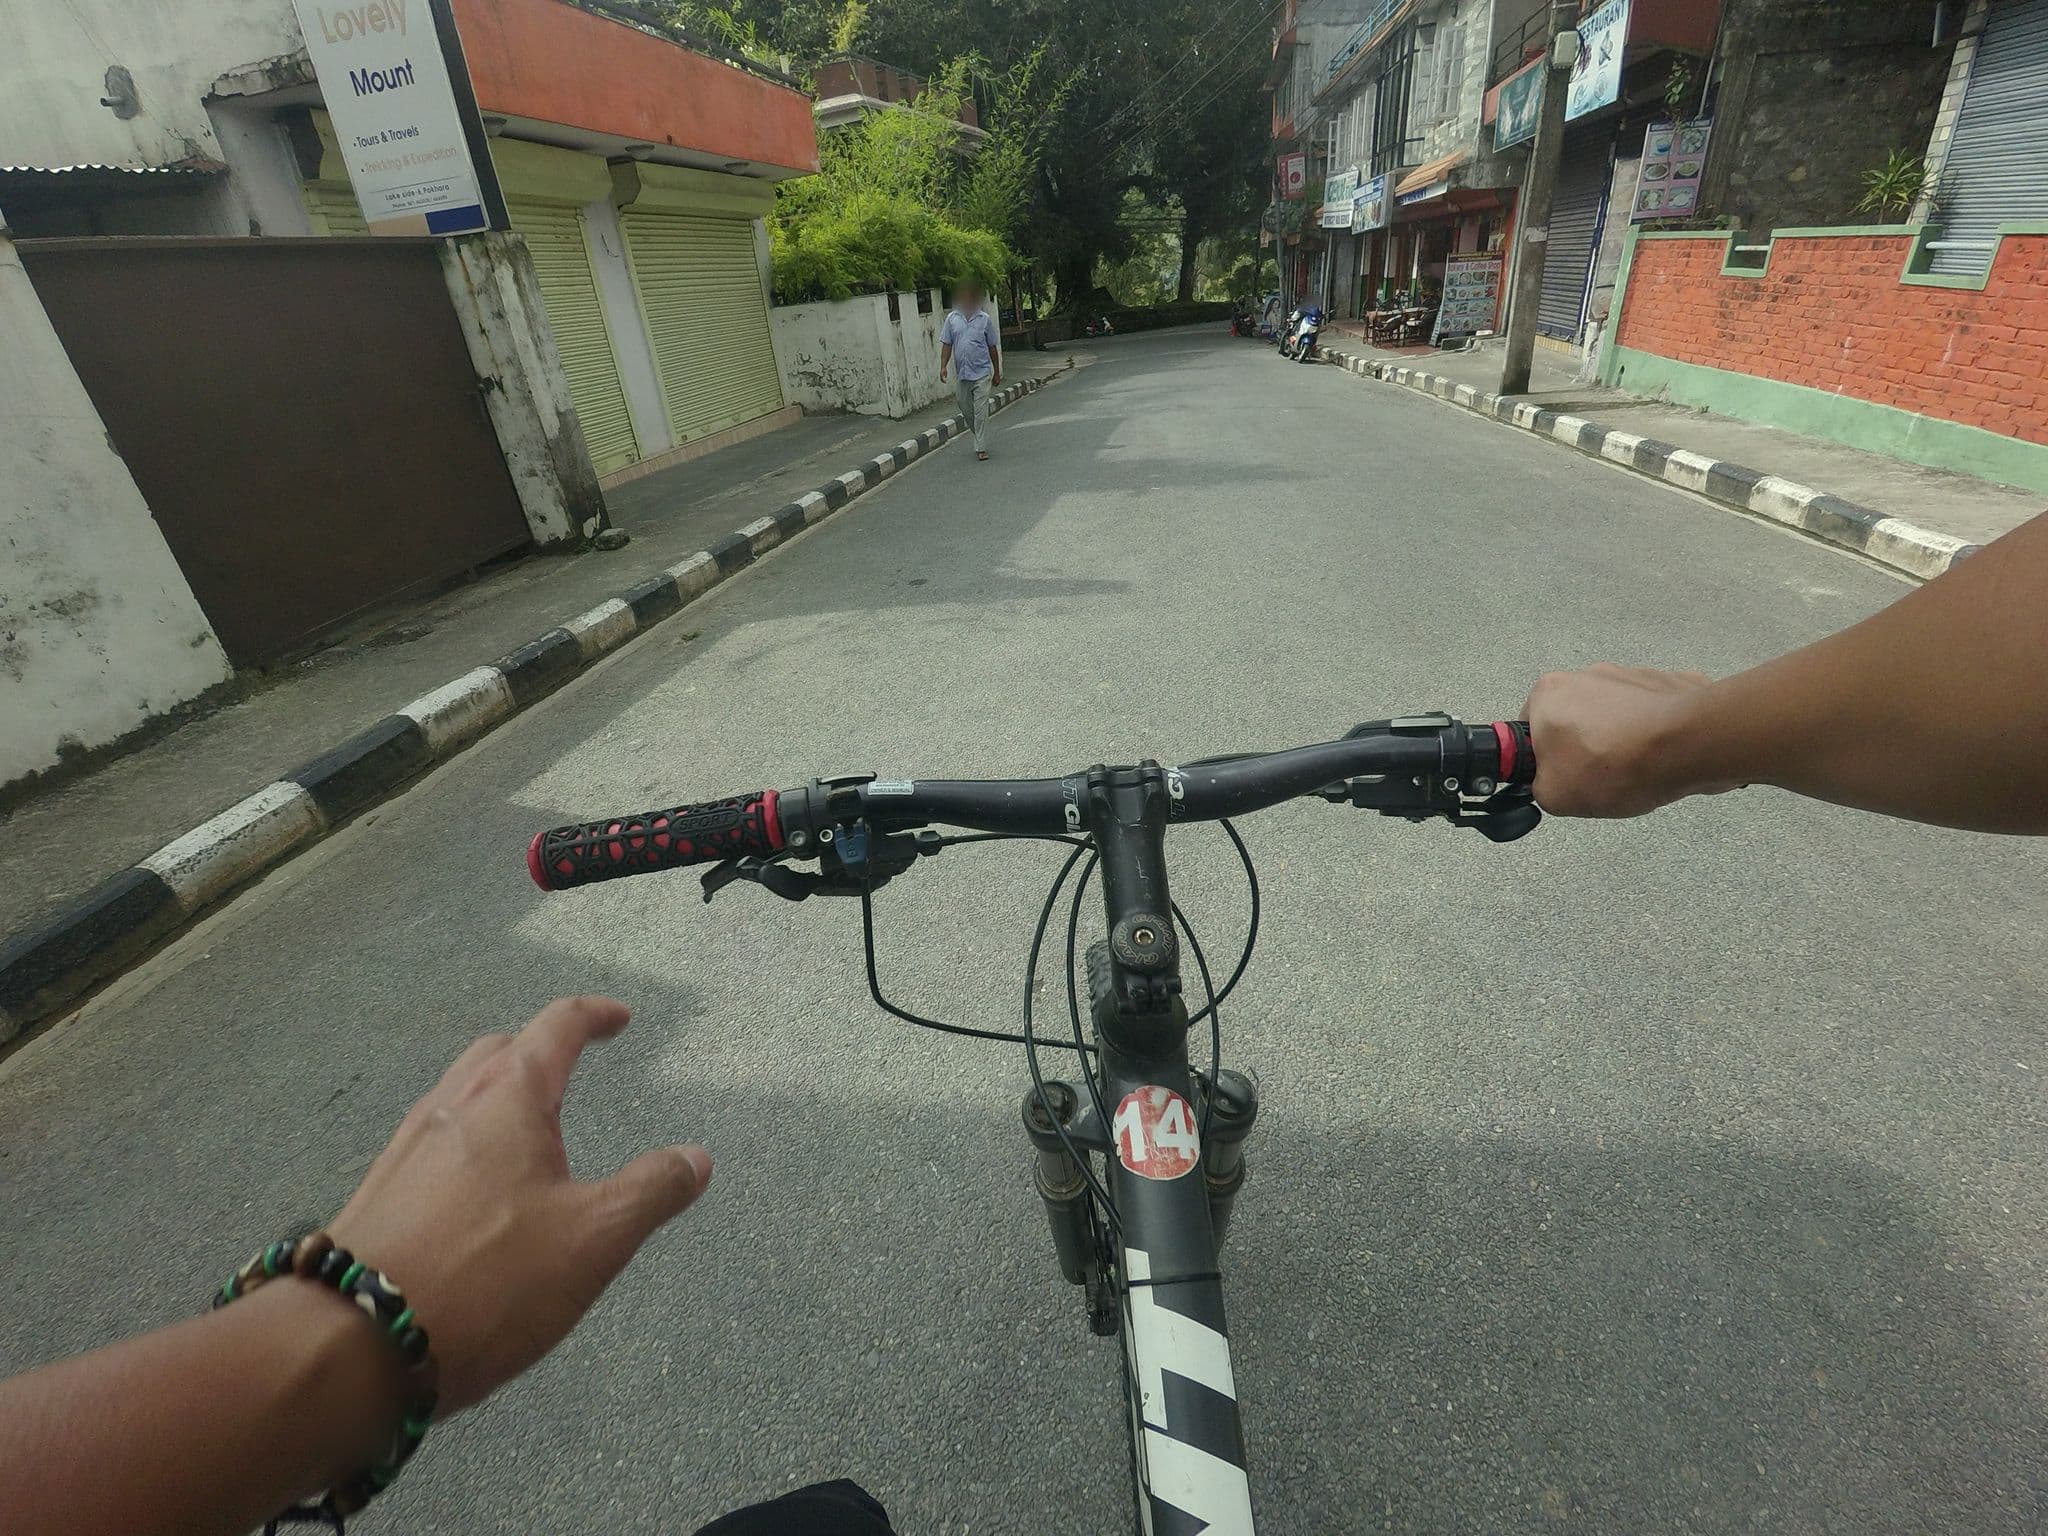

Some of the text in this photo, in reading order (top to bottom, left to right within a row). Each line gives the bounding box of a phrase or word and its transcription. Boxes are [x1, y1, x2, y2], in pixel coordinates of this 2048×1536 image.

[317, 0, 407, 44] Lovely
[349, 58, 415, 97] Mount
[356, 125, 420, 148] Tours & Travels
[679, 812, 731, 832] SPORT
[1113, 1099, 1196, 1162] 14
